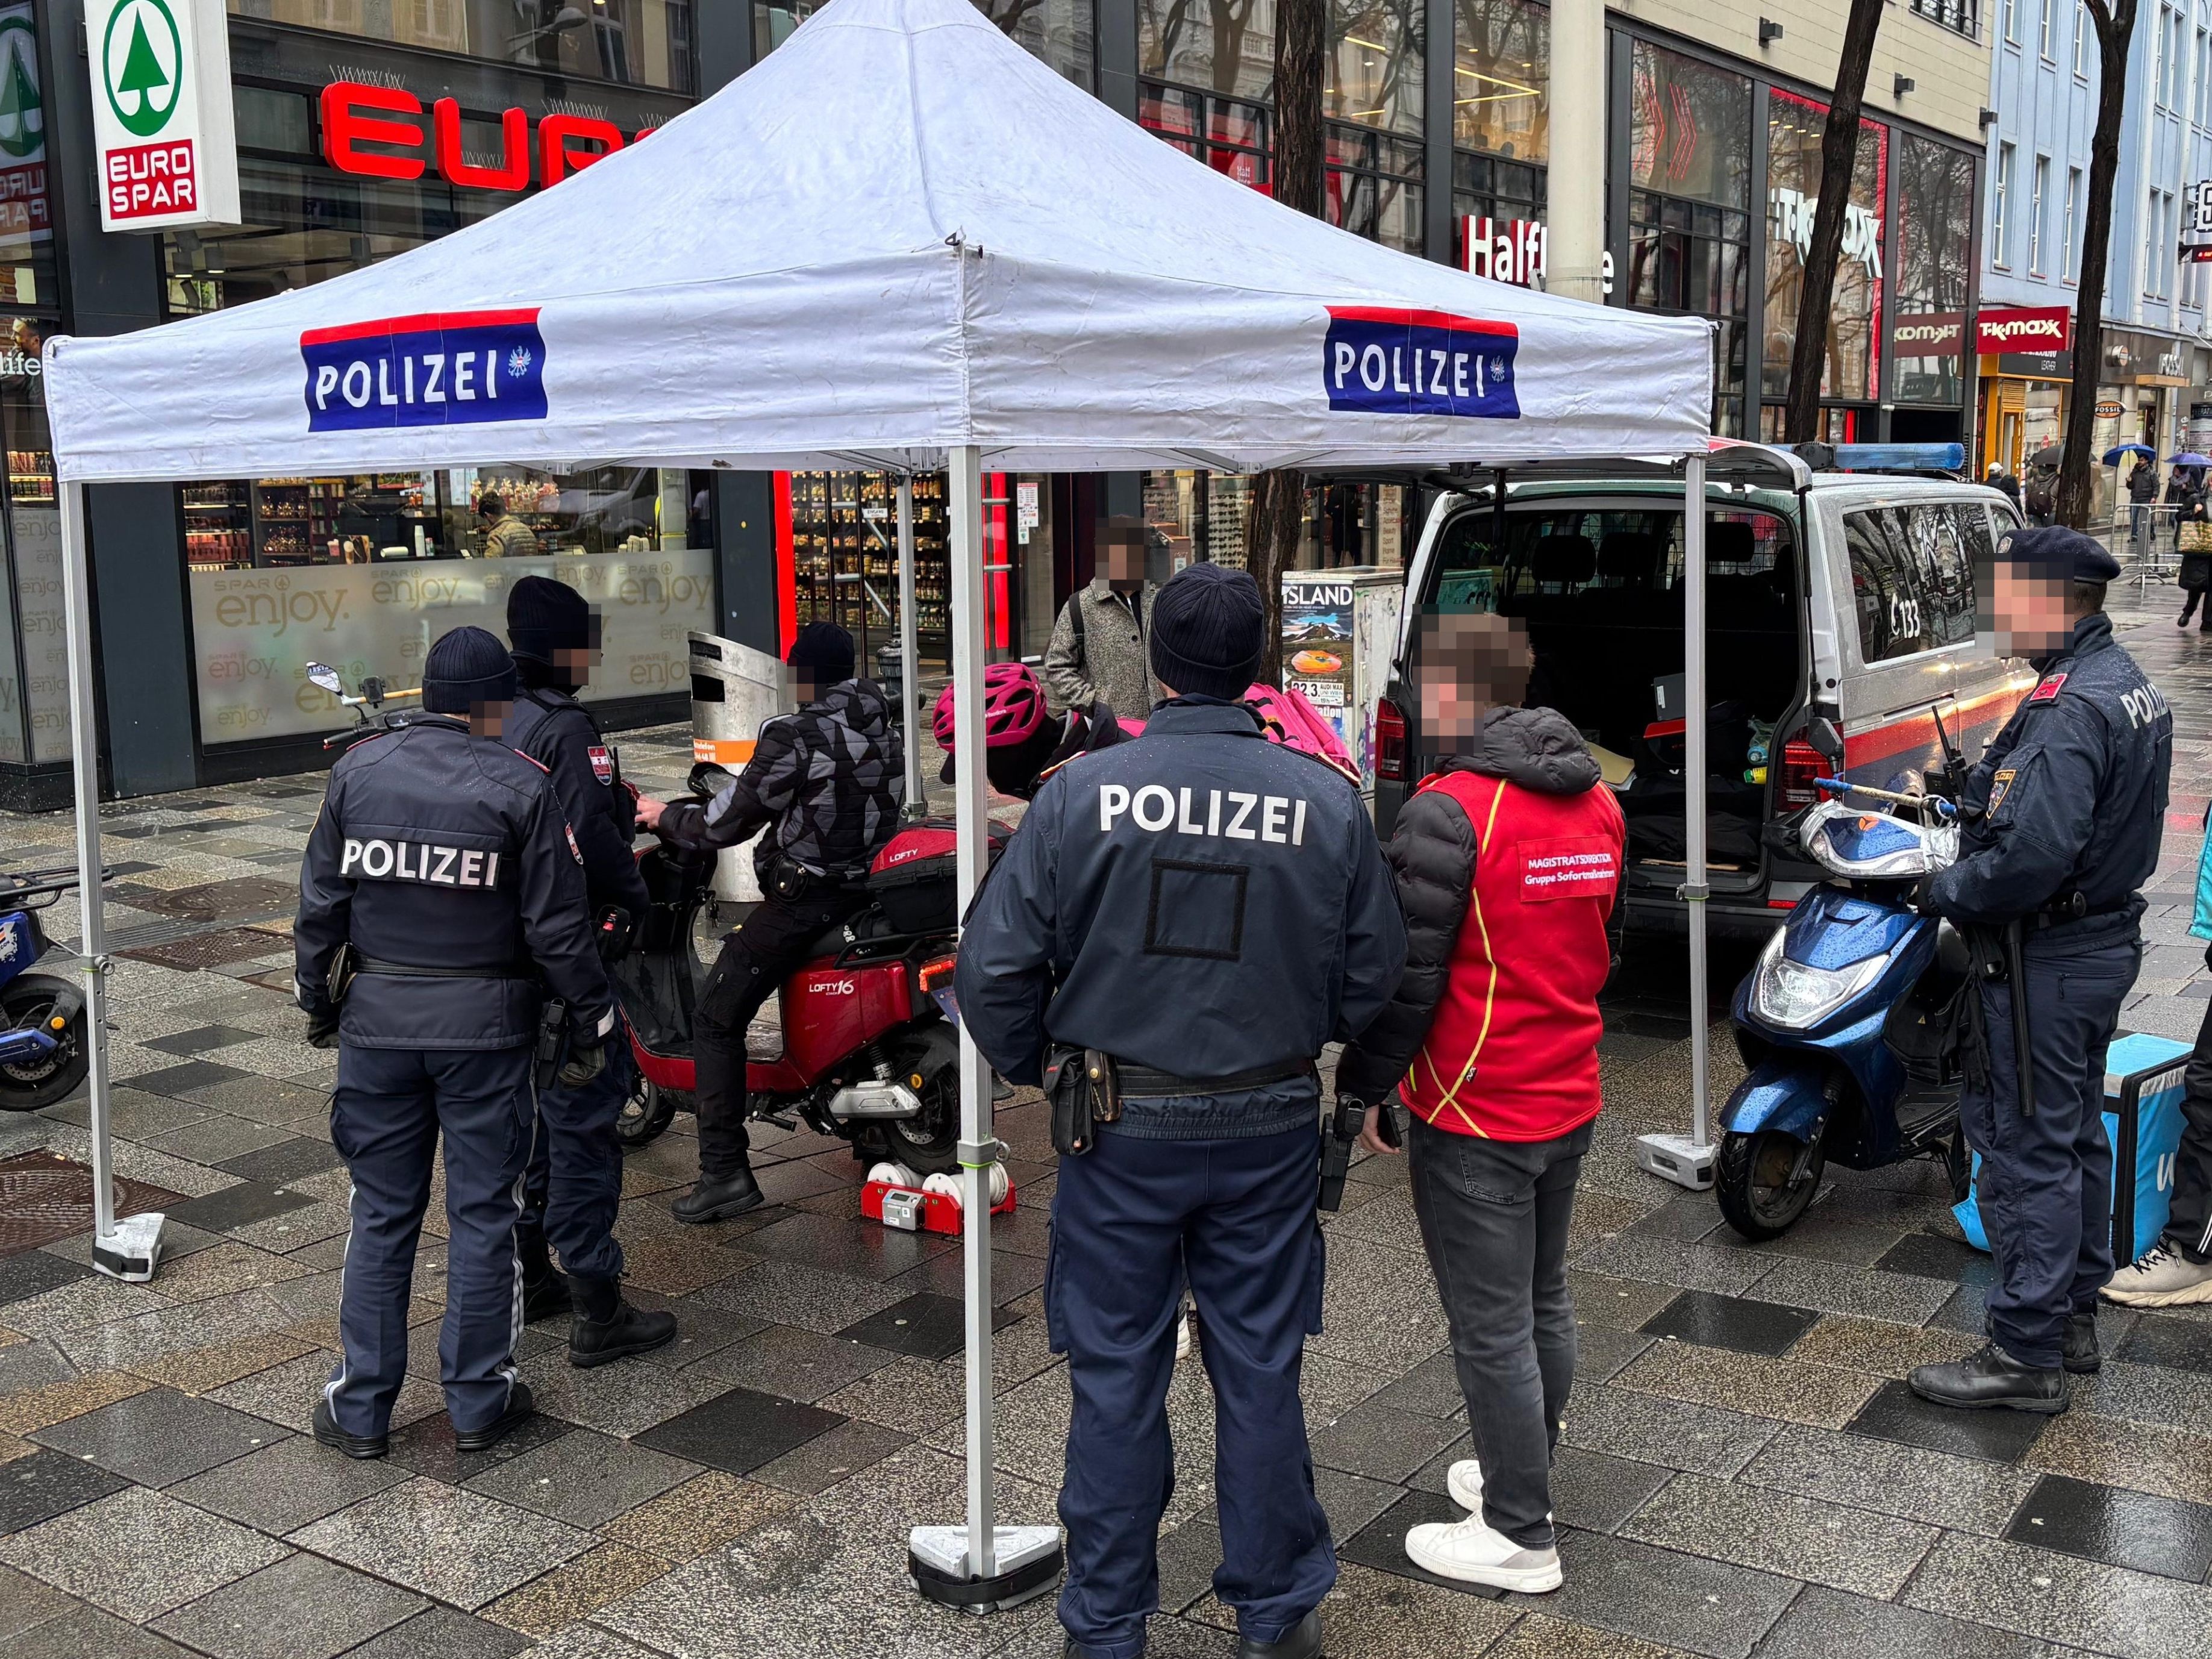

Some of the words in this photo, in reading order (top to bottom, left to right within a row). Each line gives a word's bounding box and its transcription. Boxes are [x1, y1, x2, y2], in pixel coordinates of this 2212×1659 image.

[321, 81, 657, 192] EUR
[110, 147, 190, 182] EURO
[112, 178, 193, 212] SPAR
[315, 350, 498, 410] POLIZEI
[1334, 342, 1485, 398] POLIZEI
[14, 522, 61, 541] enjo
[214, 578, 270, 592] SPAR
[1283, 586, 1353, 605] ISLAND
[23, 616, 67, 636] enjo
[1899, 599, 1920, 639] 133
[630, 661, 689, 690] enjo
[2119, 683, 2169, 730] POLIZ
[1099, 784, 1307, 846] POLIZEI
[341, 839, 499, 887] POLIZEI
[889, 849, 918, 863] LOFTY
[1525, 873, 1556, 886] Gruppe
